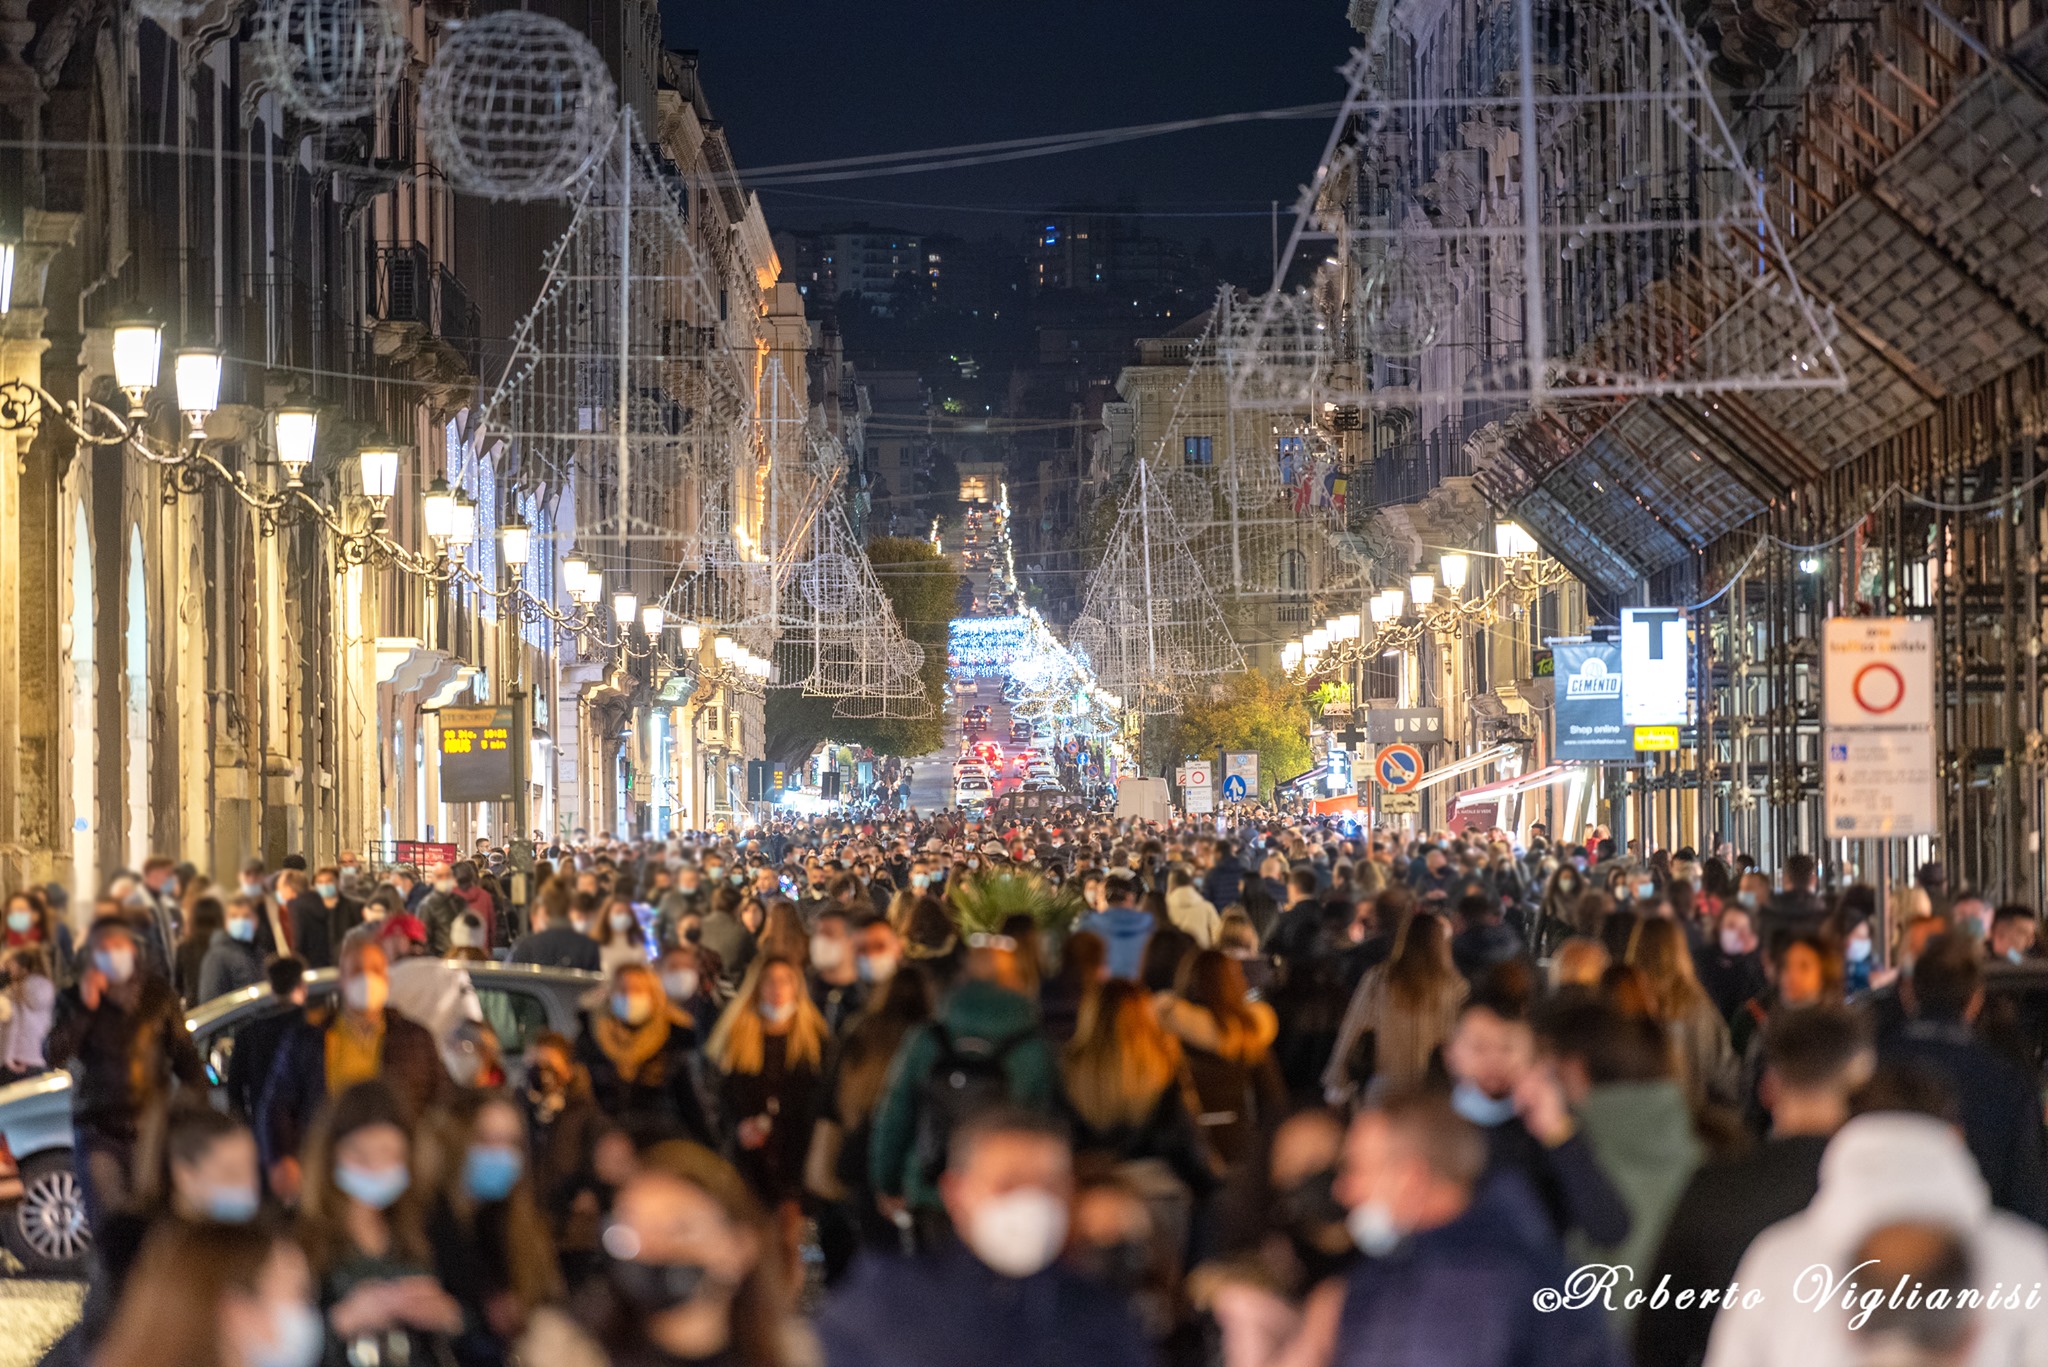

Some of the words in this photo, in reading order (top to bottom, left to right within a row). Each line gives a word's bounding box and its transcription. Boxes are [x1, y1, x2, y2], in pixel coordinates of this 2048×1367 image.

[1632, 612, 1679, 660] T
[1571, 678, 1618, 693] CEMENTO
[1569, 724, 1593, 736] Shop
[1593, 724, 1621, 734] online
